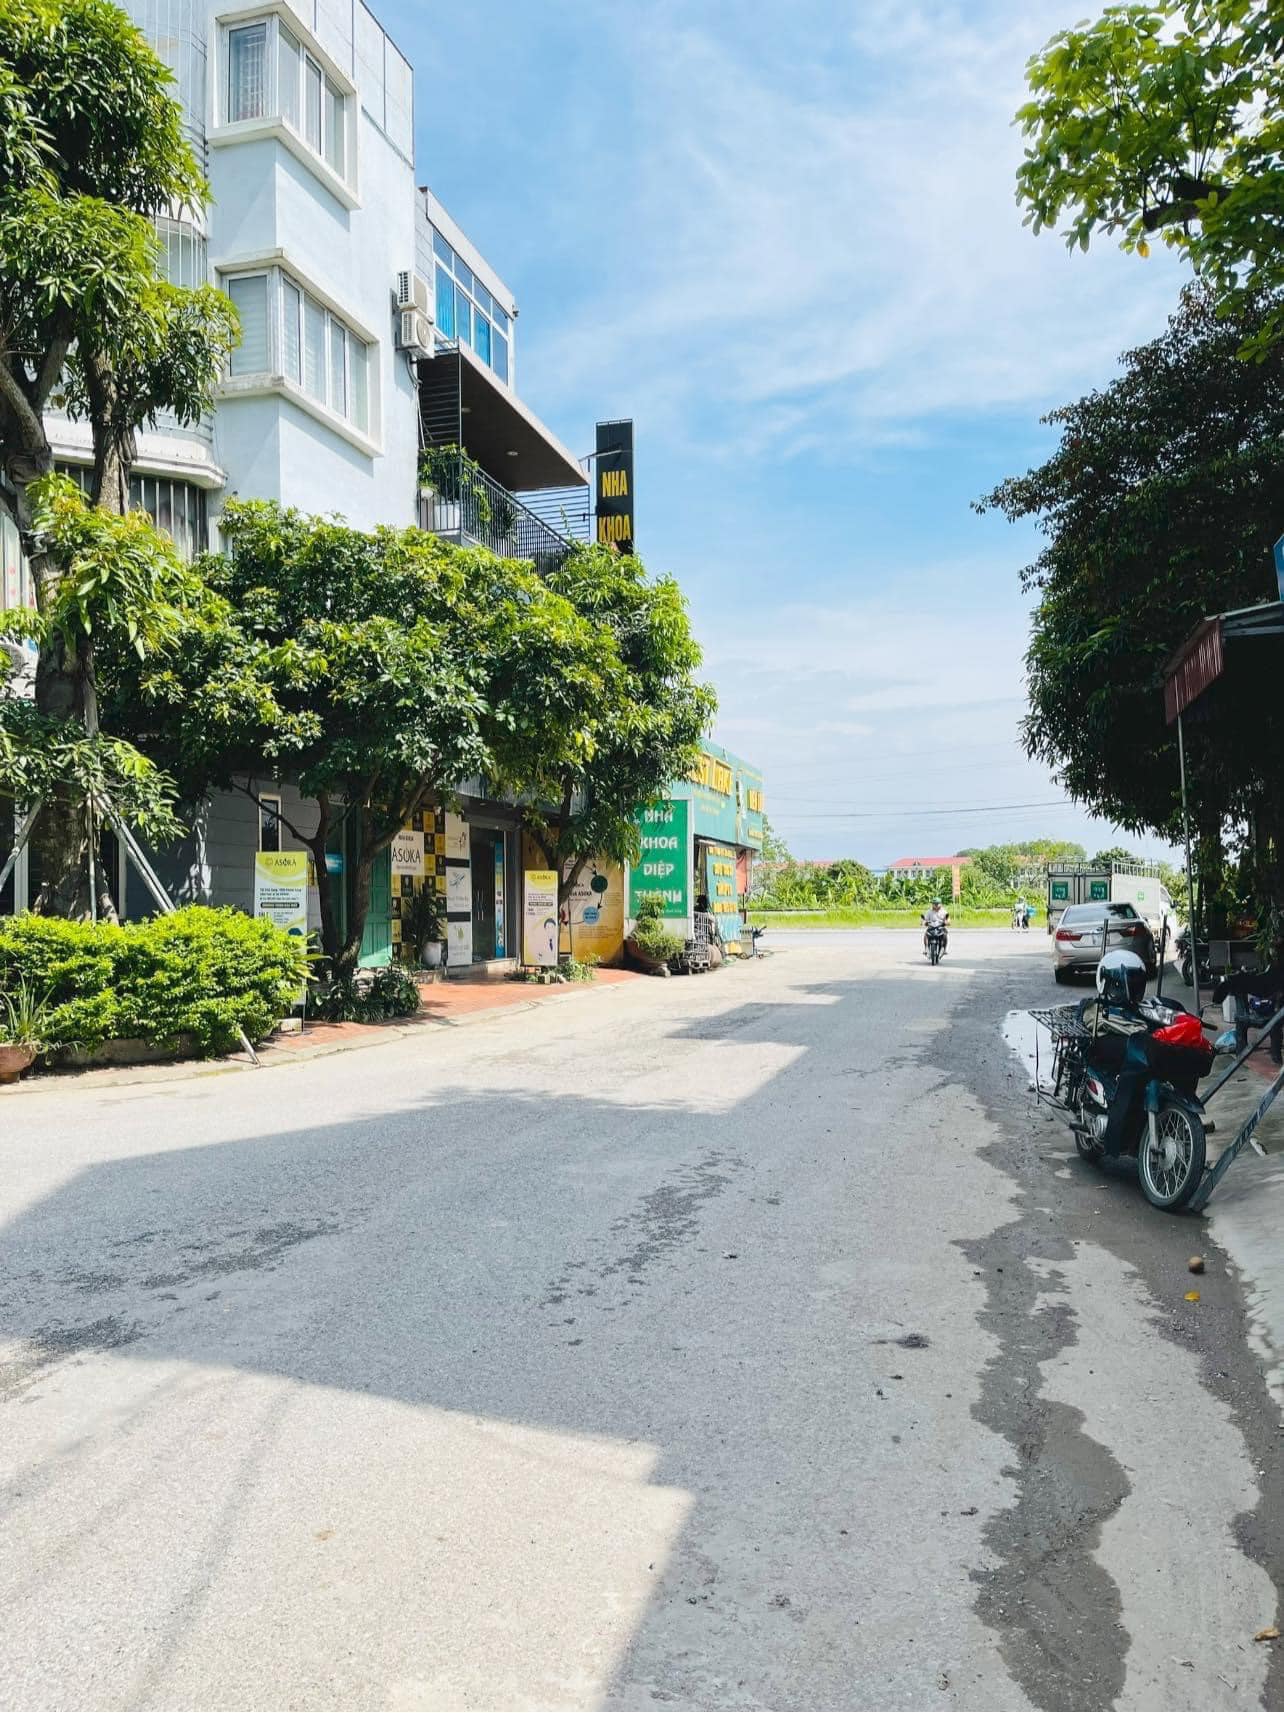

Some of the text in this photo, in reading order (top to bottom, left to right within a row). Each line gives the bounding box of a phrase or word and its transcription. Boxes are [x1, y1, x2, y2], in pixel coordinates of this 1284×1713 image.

[602, 470, 628, 498] NHA
[598, 514, 631, 542] KHOA
[640, 836, 678, 850] KHOA
[274, 858, 297, 867] ASOKA
[391, 847, 421, 864] ASOKA
[643, 860, 675, 879] DIỆP
